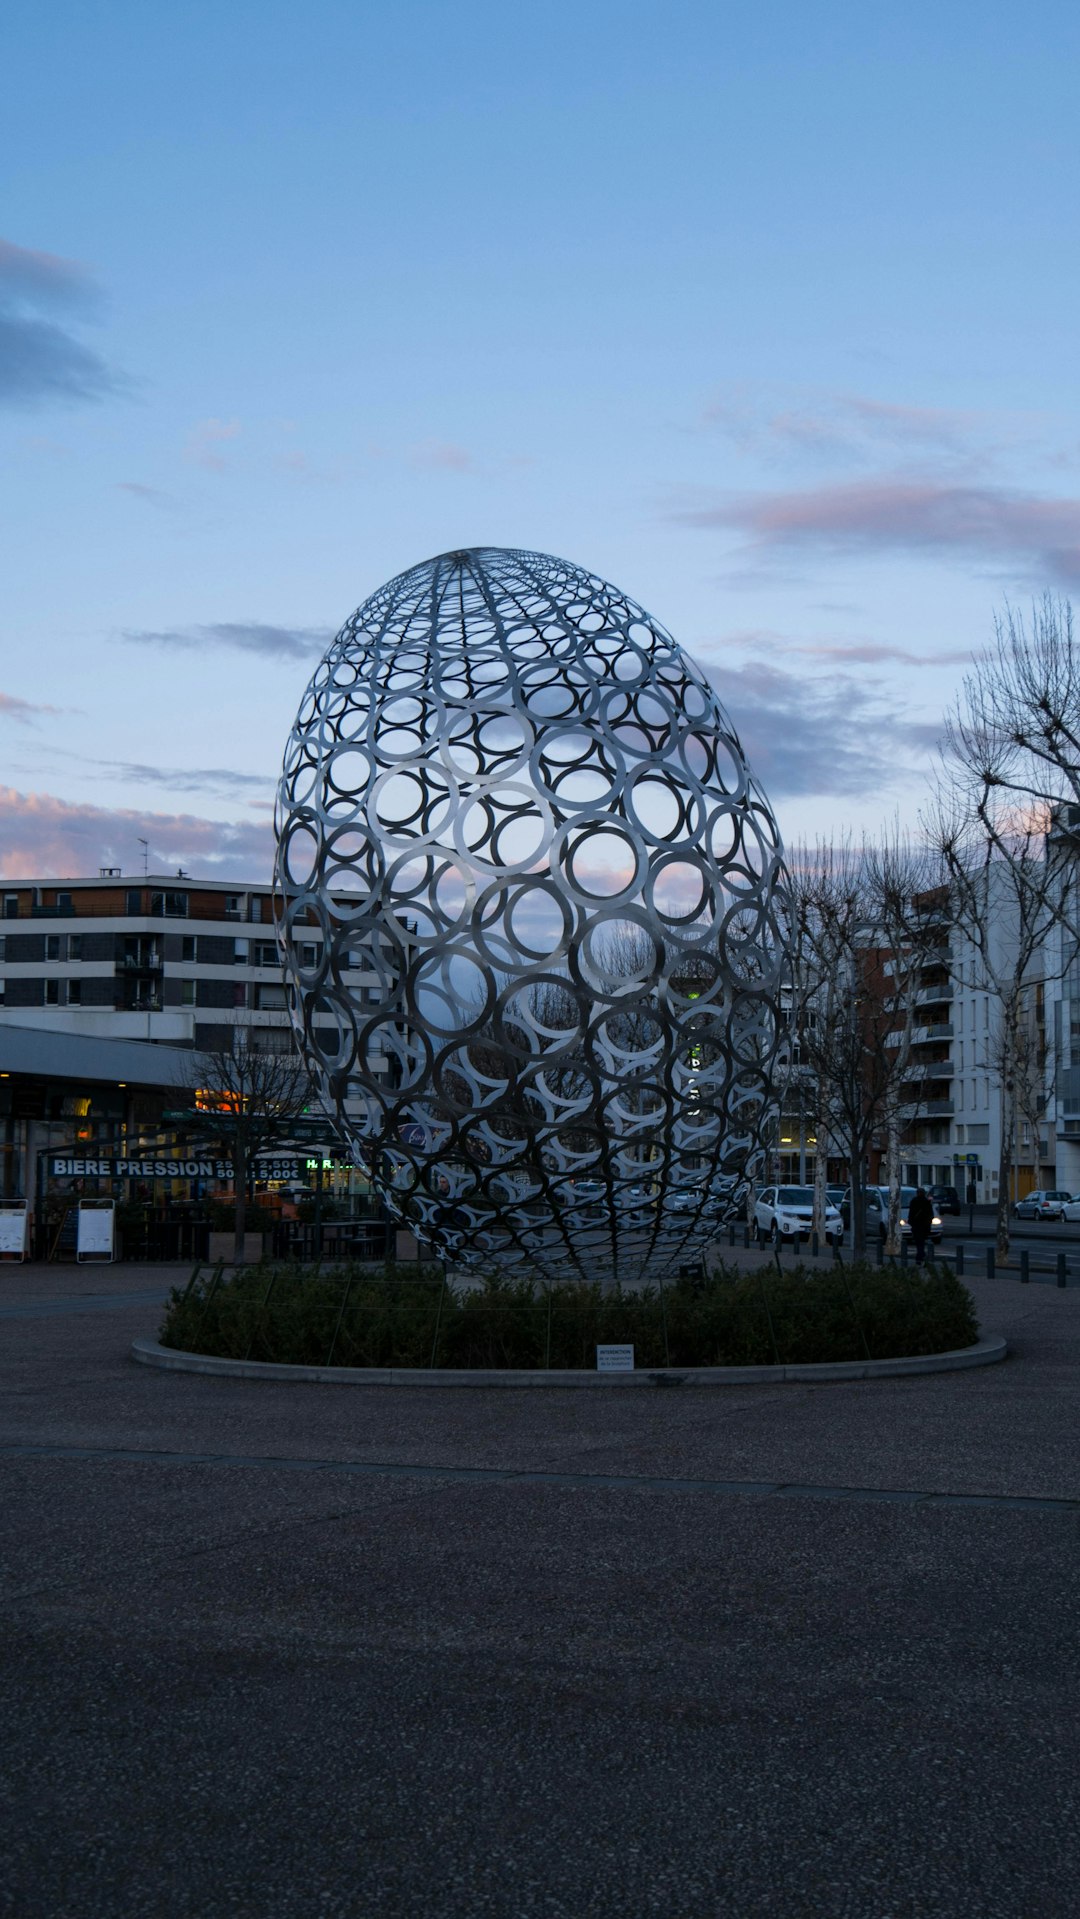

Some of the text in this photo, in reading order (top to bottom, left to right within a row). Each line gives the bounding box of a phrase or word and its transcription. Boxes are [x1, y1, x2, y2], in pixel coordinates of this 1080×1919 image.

[53, 1159, 214, 1176] BIERE PRESSION
[258, 1160, 299, 1170] 2,50€
[259, 1169, 299, 1179] 5,00€
